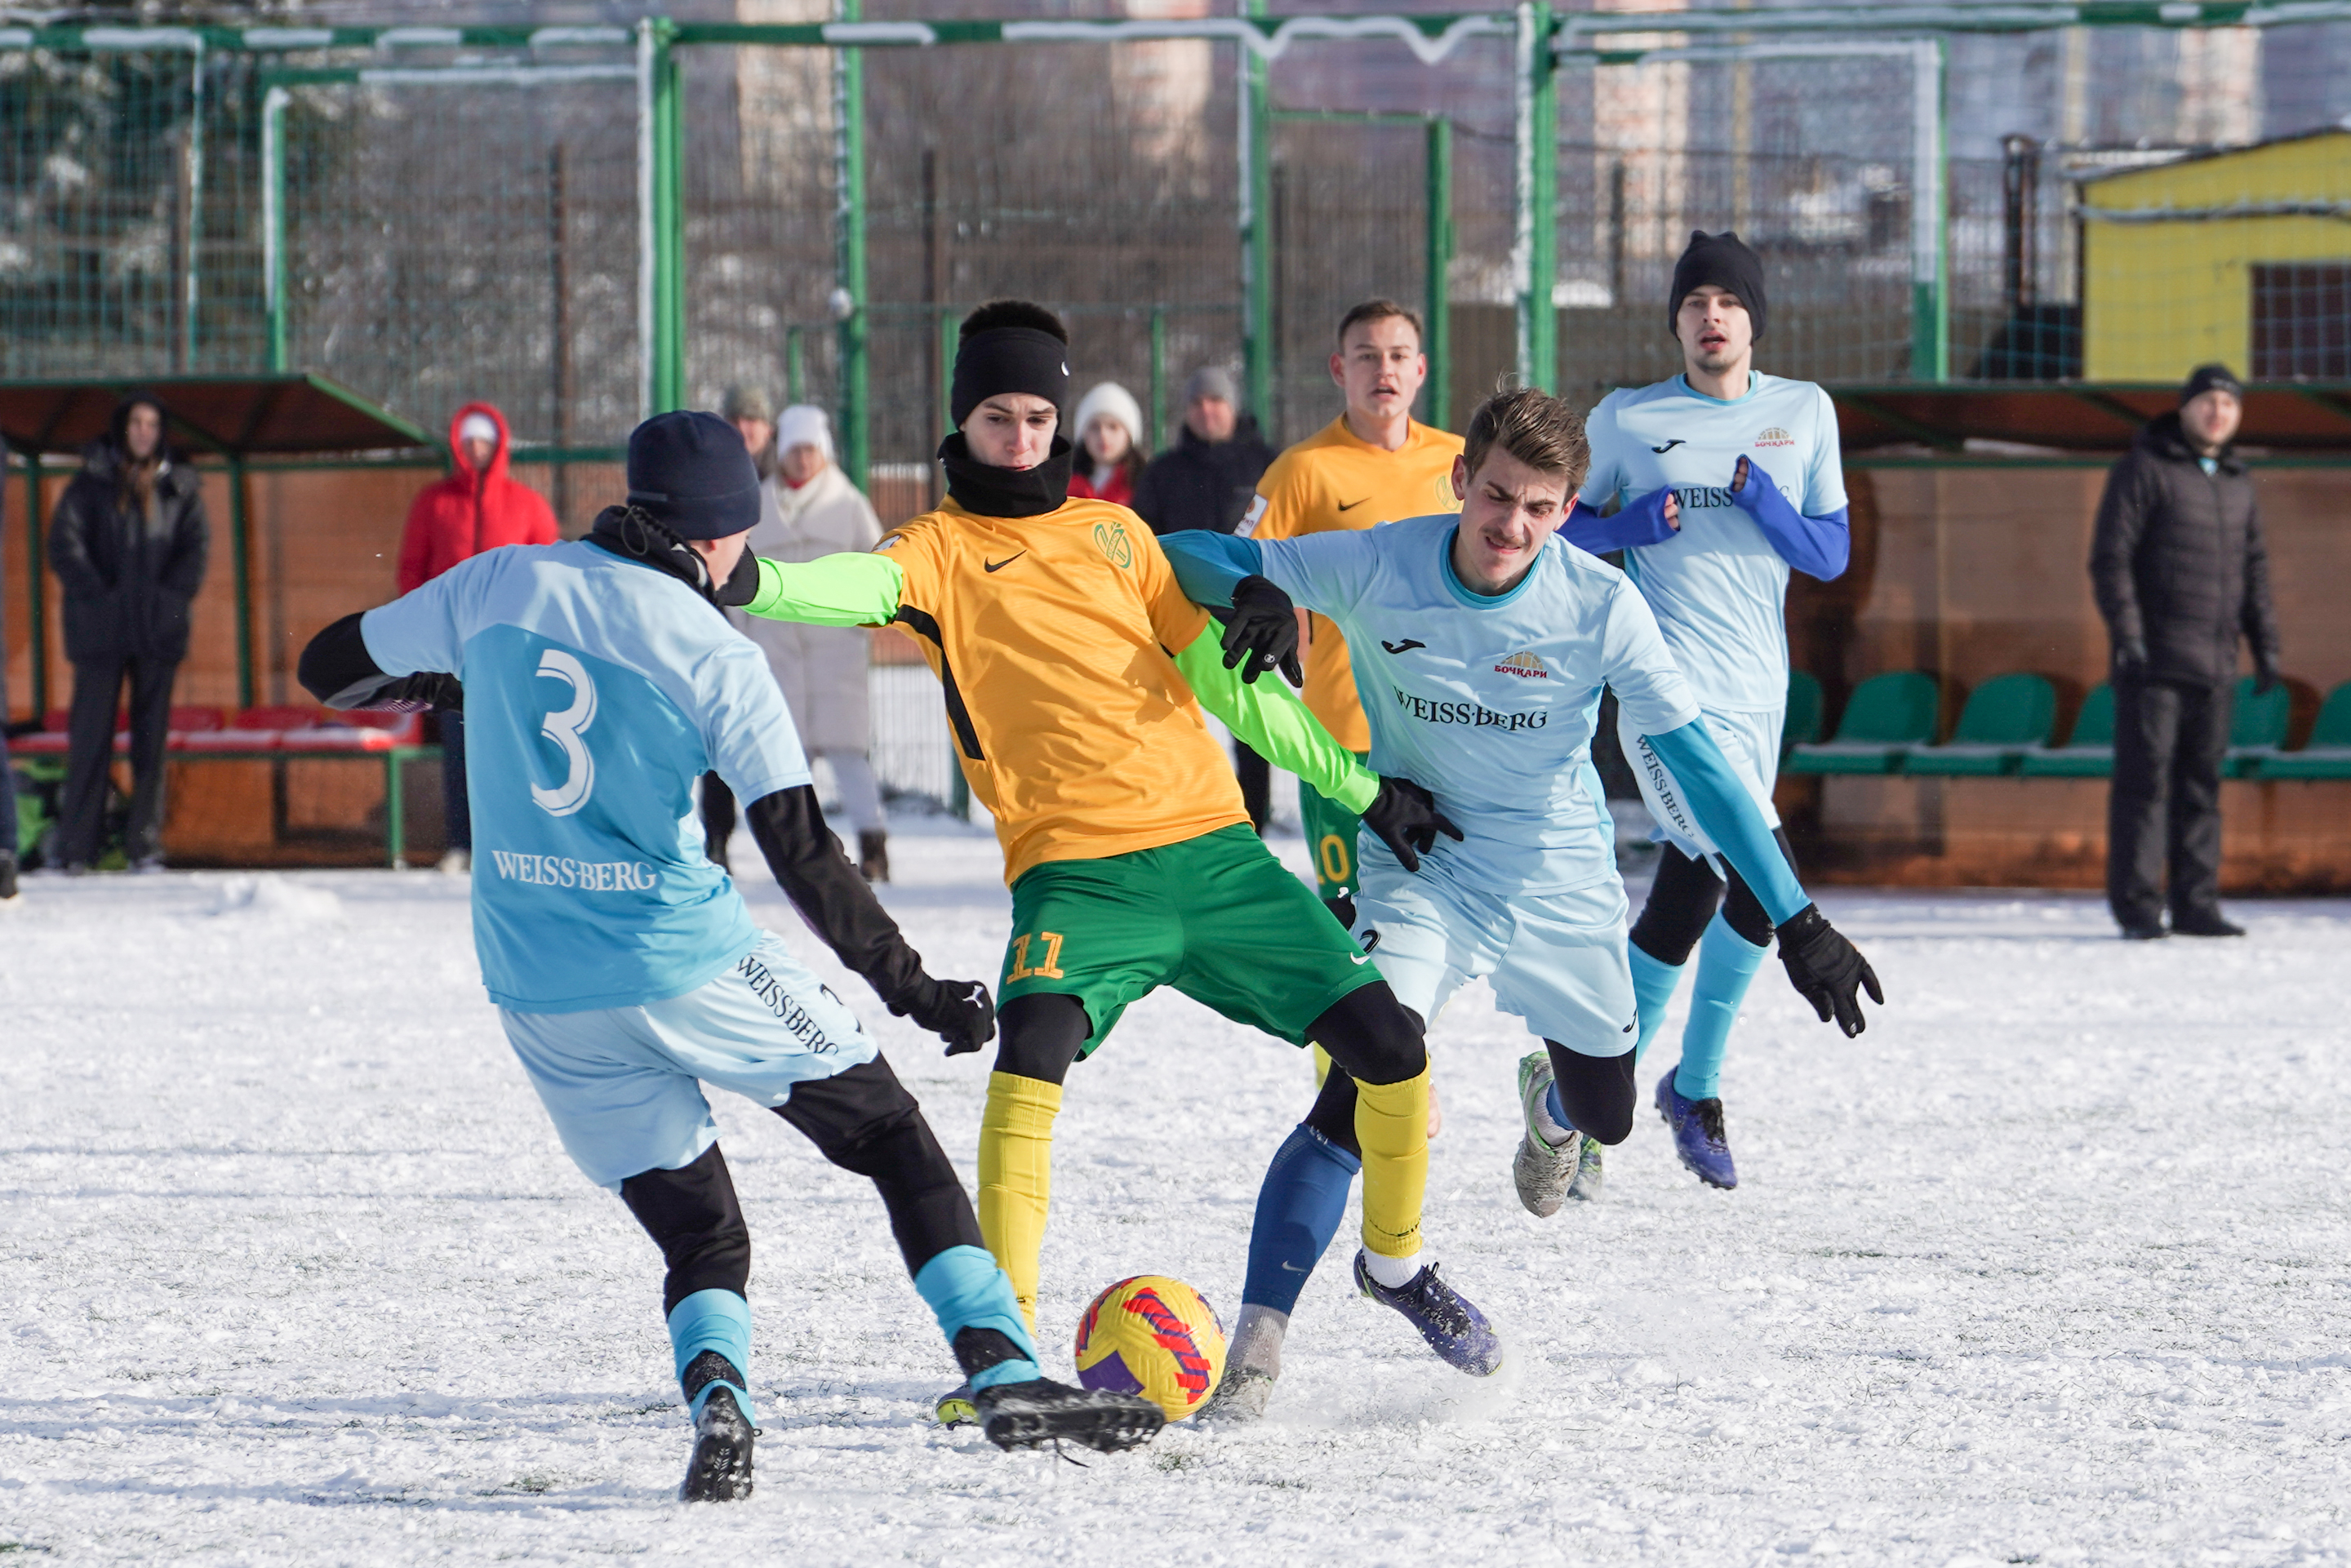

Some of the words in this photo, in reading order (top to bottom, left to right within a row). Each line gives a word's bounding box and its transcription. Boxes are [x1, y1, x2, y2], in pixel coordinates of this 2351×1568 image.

[1494, 664, 1548, 679] БОЧКАРИ
[530, 648, 598, 817] 3
[1005, 931, 1064, 985] 11
